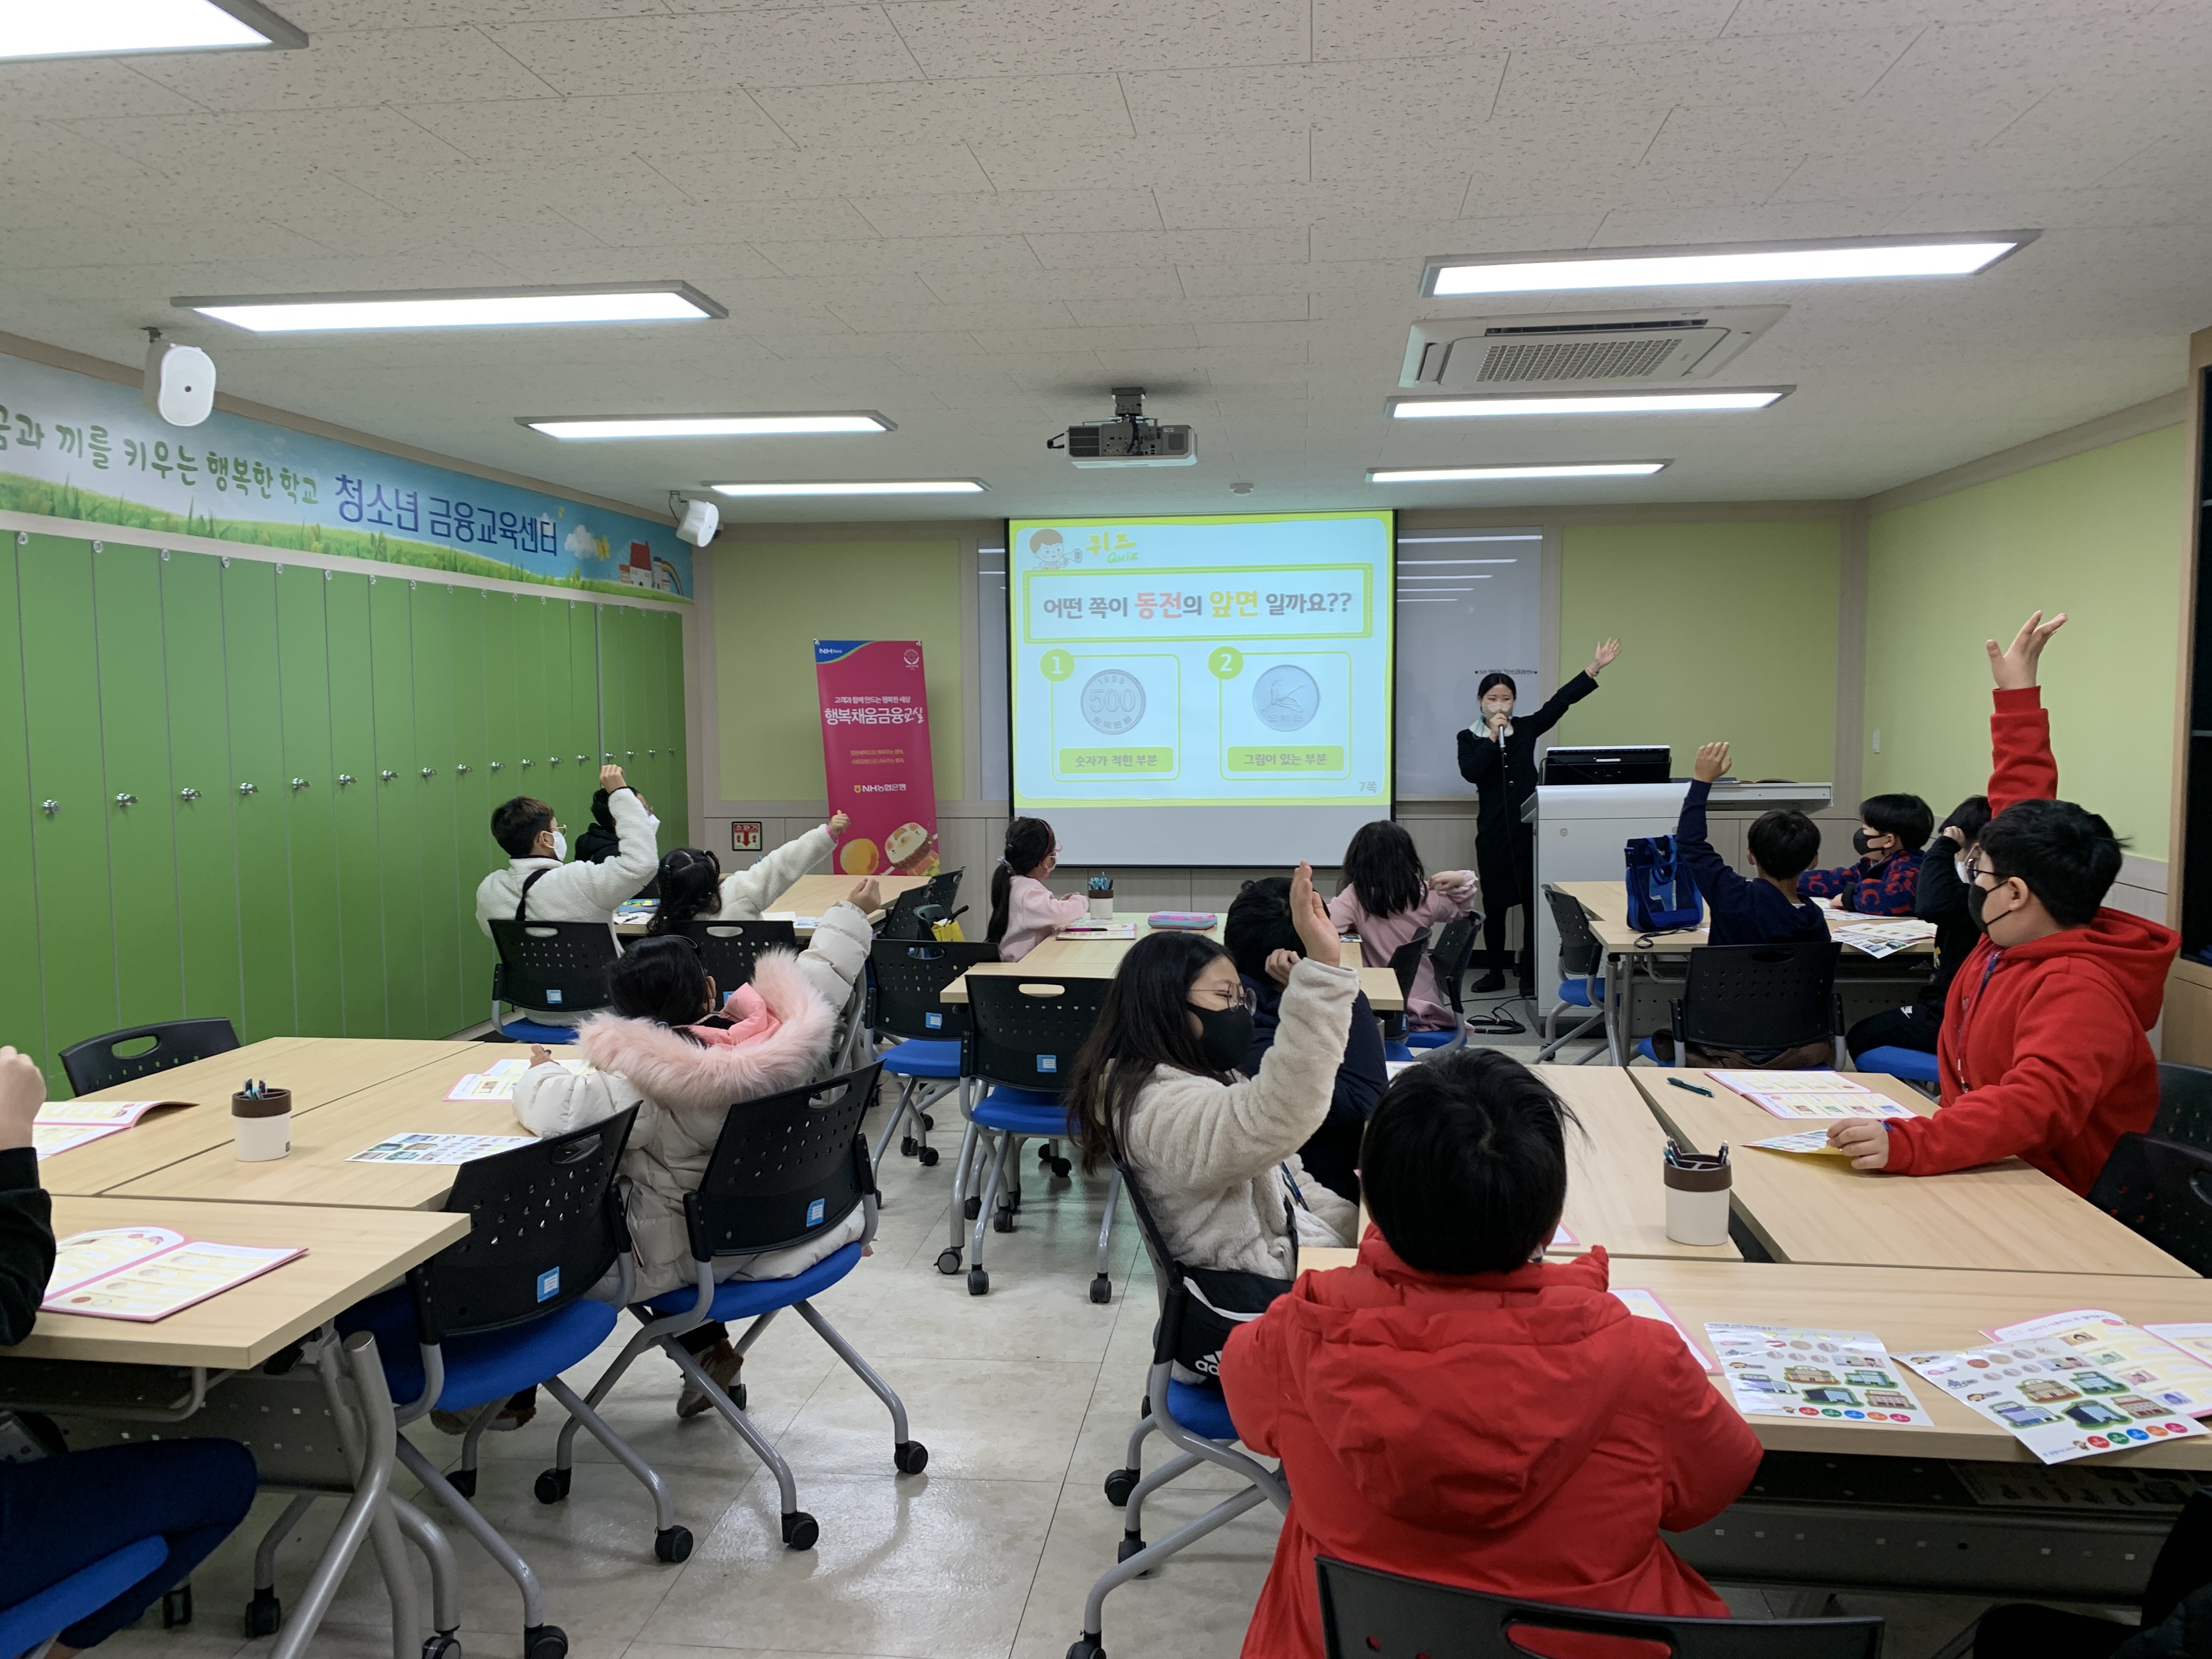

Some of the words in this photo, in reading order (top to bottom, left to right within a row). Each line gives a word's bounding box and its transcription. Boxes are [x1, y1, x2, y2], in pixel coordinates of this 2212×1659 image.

[55, 424, 112, 470] 끼를
[123, 438, 199, 486] 키우는
[206, 450, 274, 499] 행복한
[279, 467, 319, 505] 학교
[334, 473, 419, 533] 청소년
[428, 496, 558, 557] 금융교육센터
[1043, 597, 1083, 619] 어떤
[1088, 596, 1127, 619] 쪽이
[1134, 591, 1202, 620] 동전의
[1209, 590, 1259, 618] 앞면
[1265, 592, 1352, 616] 일까요??
[1051, 657, 1063, 675] 1
[1220, 654, 1233, 672] 2
[1090, 688, 1136, 713] 500
[824, 707, 924, 725] 행복채움금융교실
[1075, 755, 1108, 768] 숫자가
[1111, 754, 1133, 767] 적힌
[1136, 754, 1158, 766] 부분
[1243, 754, 1276, 766] 그림이
[1279, 753, 1302, 765] 있는
[1305, 753, 1327, 765] 부분
[1358, 781, 1378, 793] 7쪽
